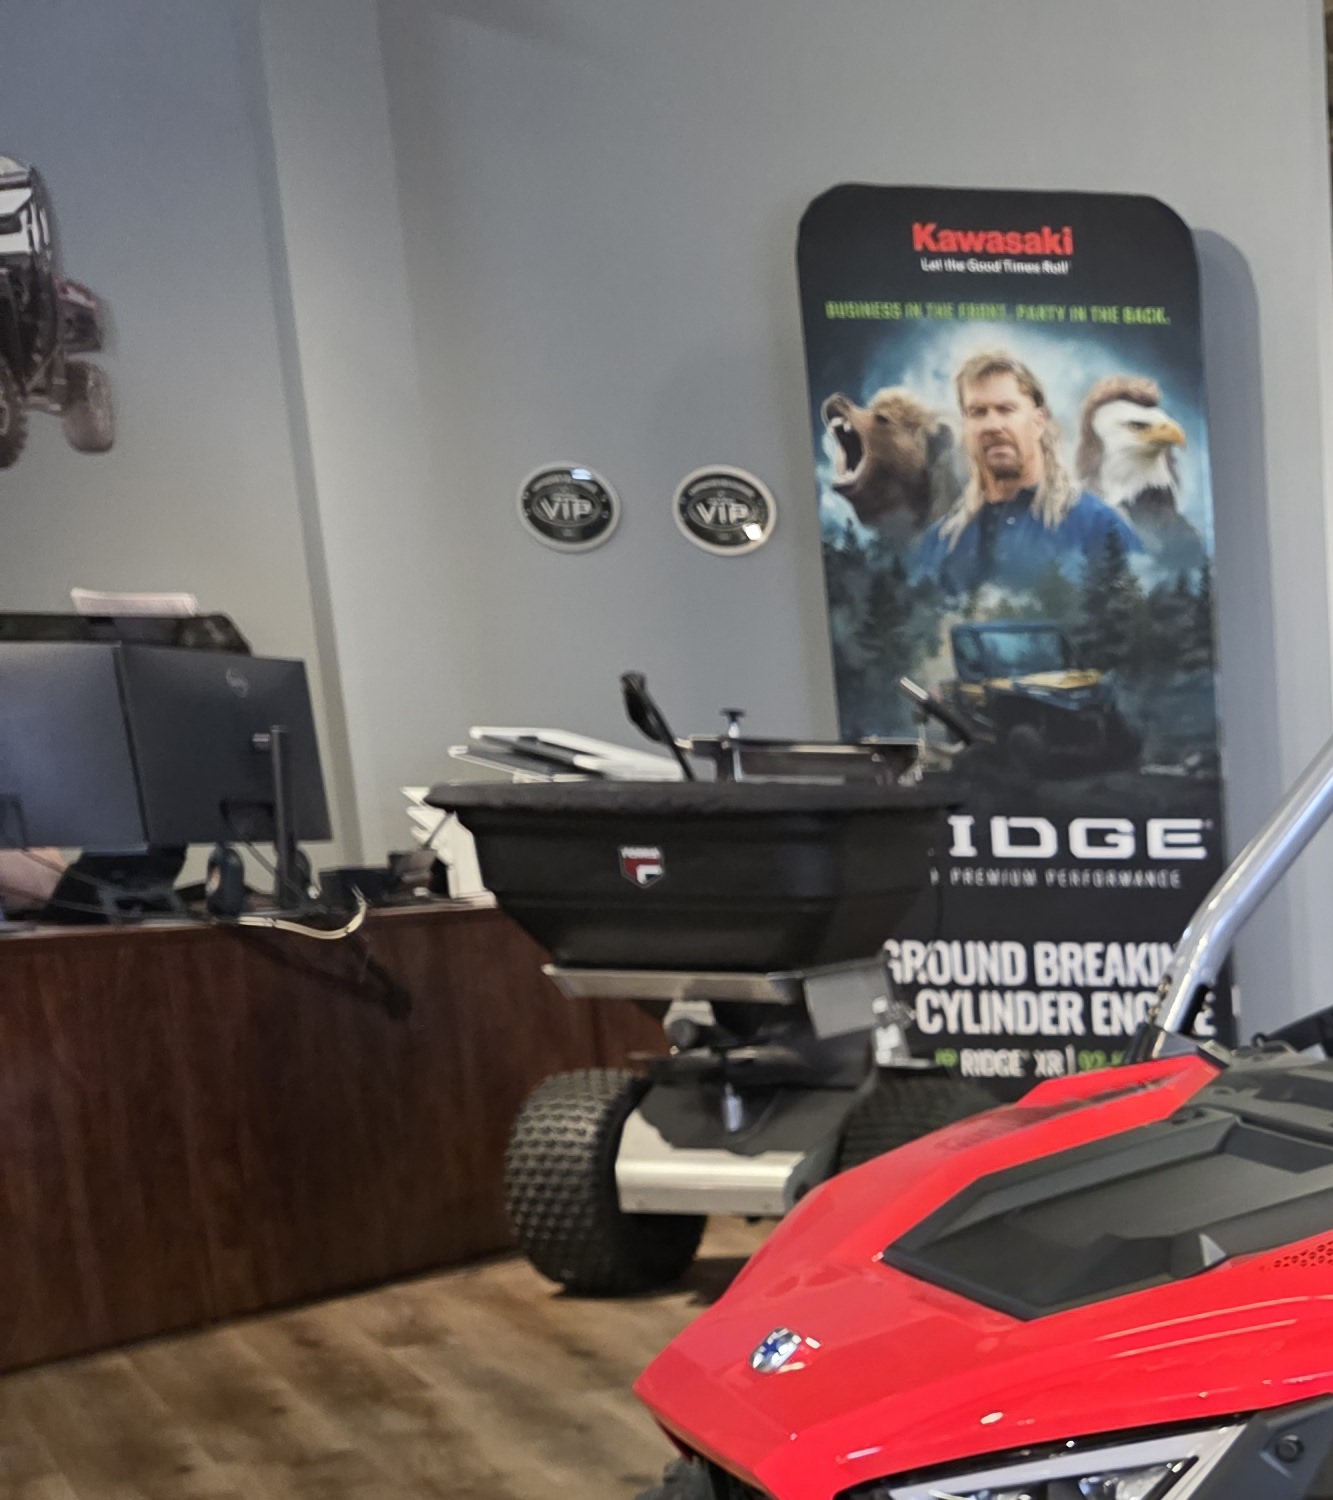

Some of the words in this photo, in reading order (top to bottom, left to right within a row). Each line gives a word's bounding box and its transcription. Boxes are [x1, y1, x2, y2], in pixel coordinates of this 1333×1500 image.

[912, 222, 1073, 255] Kawasaki
[966, 257, 1000, 274] Good
[1002, 259, 1040, 275] Times
[825, 301, 900, 320] BUSINESS
[903, 302, 922, 320] IN
[925, 302, 954, 320] THE
[1016, 304, 1066, 323] PARTY
[1070, 305, 1087, 323] IN
[1091, 305, 1120, 324] THE
[948, 815, 1208, 859] IDGE
[950, 867, 1038, 888] PREMIUM
[1045, 868, 1182, 889] PERFORMANCE
[883, 938, 1028, 987] GROUND
[915, 988, 1086, 1036] CYLINDER
[1033, 1049, 1066, 1079] XR
